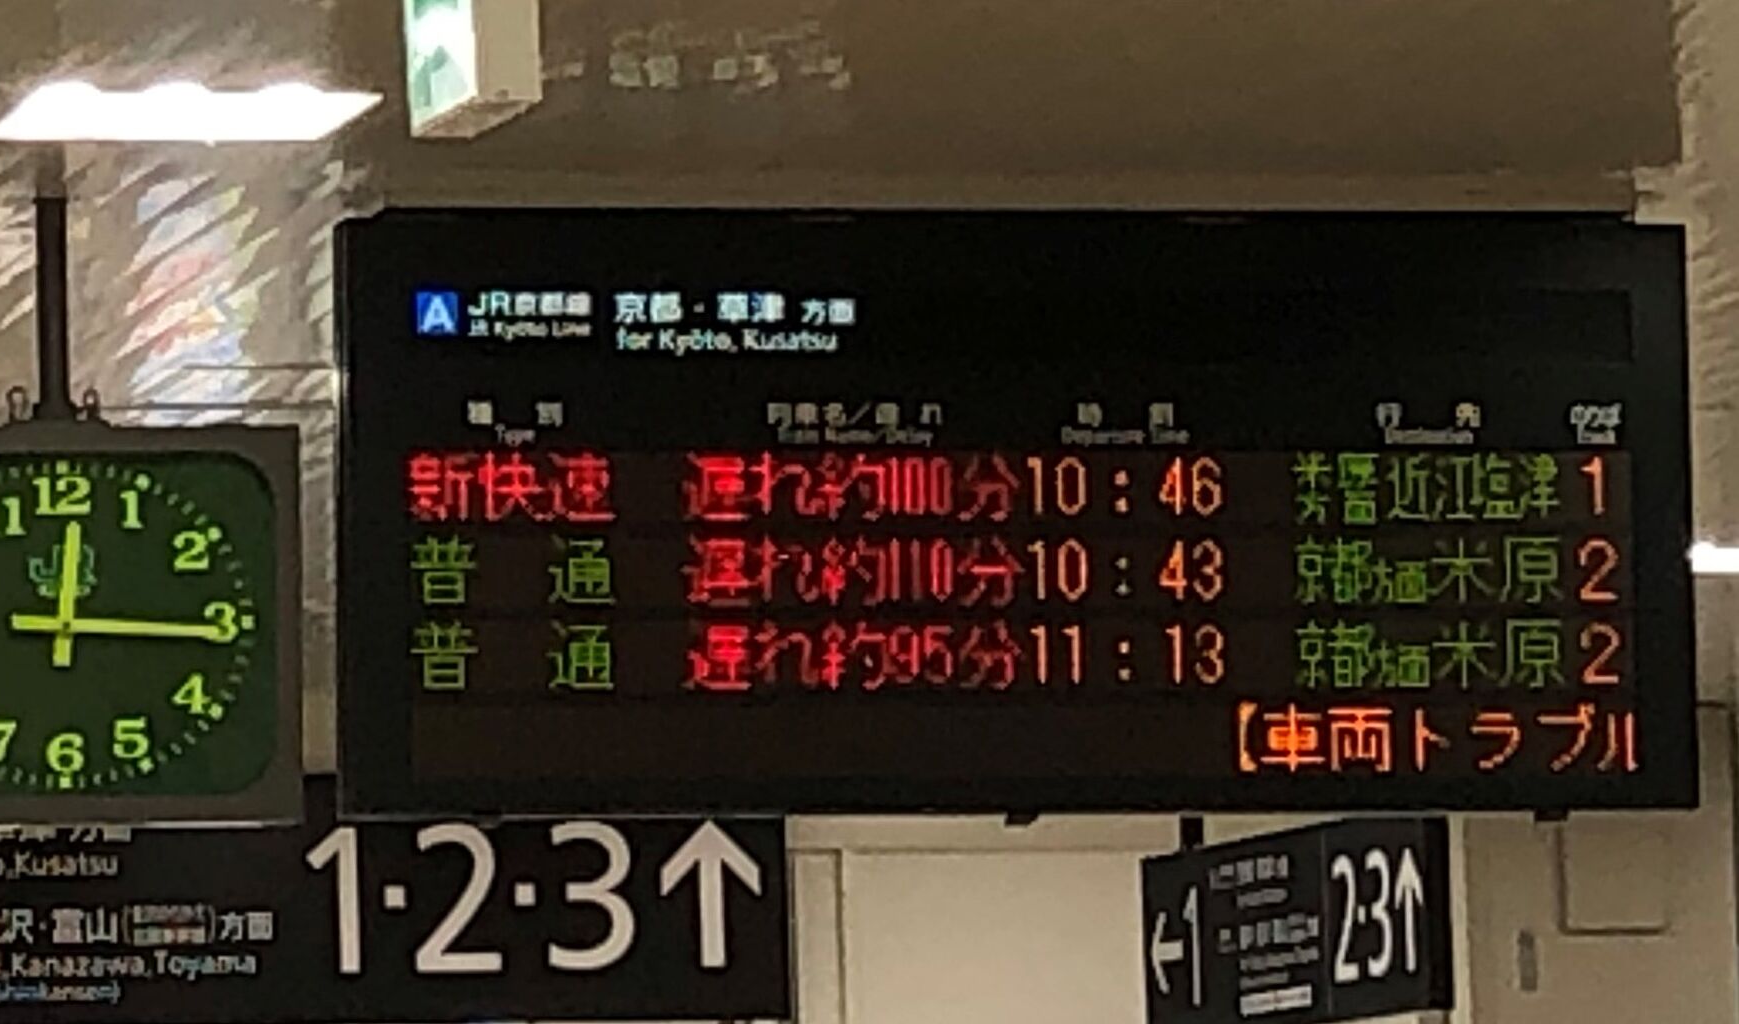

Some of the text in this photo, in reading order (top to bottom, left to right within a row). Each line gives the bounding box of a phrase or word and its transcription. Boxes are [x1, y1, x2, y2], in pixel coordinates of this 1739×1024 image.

[418, 296, 457, 333] A
[613, 291, 857, 326] 京都・草津 方面
[615, 328, 653, 351] for
[31, 475, 92, 516] 12
[409, 450, 615, 522] 新快速
[1578, 455, 1606, 517] 1
[119, 489, 145, 530] 1
[173, 530, 210, 573] 2
[1576, 539, 1620, 601] 2
[203, 601, 239, 644] 3
[1576, 623, 1622, 686] 2
[172, 672, 212, 715] 4
[46, 732, 85, 774] 6
[112, 716, 150, 759] 5
[1182, 884, 1201, 1007] 1
